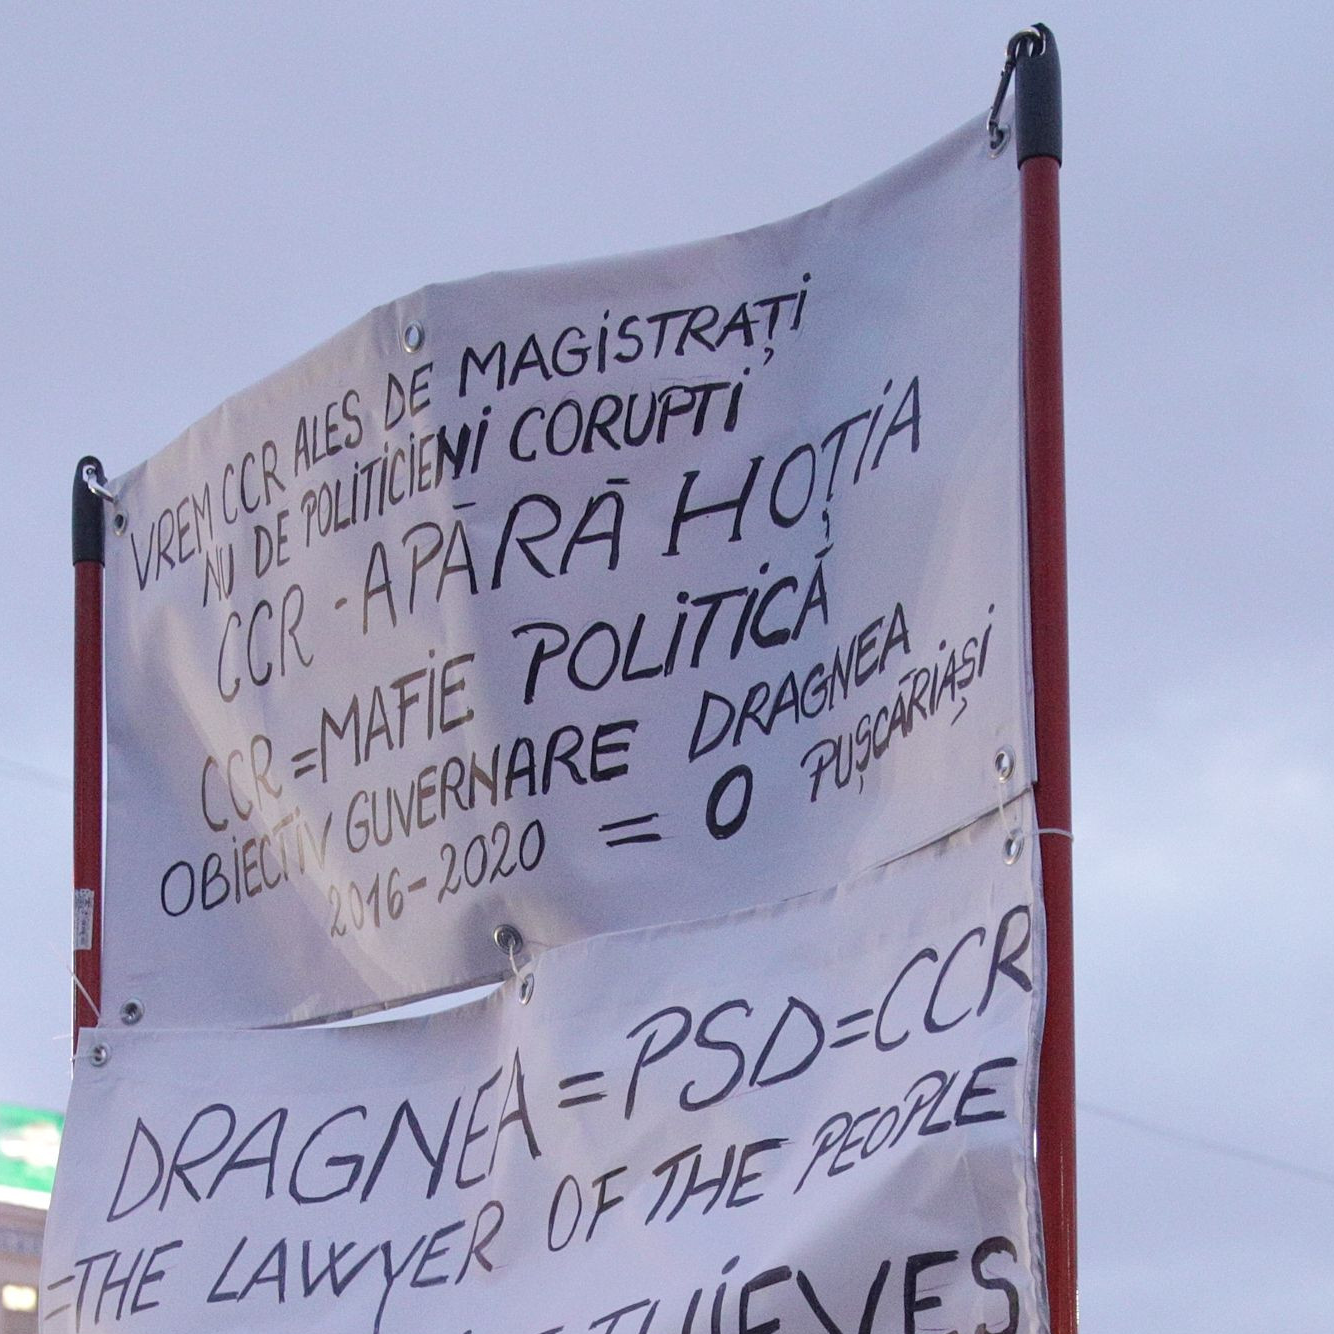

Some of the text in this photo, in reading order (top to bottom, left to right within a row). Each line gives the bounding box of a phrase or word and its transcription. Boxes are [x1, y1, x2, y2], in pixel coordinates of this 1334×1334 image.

[130, 481, 213, 591] VREM
[222, 439, 286, 525] CCR
[293, 389, 364, 478] ALES
[384, 361, 433, 431] DE
[203, 543, 235, 608] NU
[254, 509, 290, 579] DE
[218, 583, 314, 703] CCR
[160, 602, 912, 917] OBIECTIV GUVERNARE DRAGNEA
[548, 1165, 627, 1252] OF
[645, 1137, 790, 1226] THE
[793, 1057, 1018, 1194] PEOPLE
